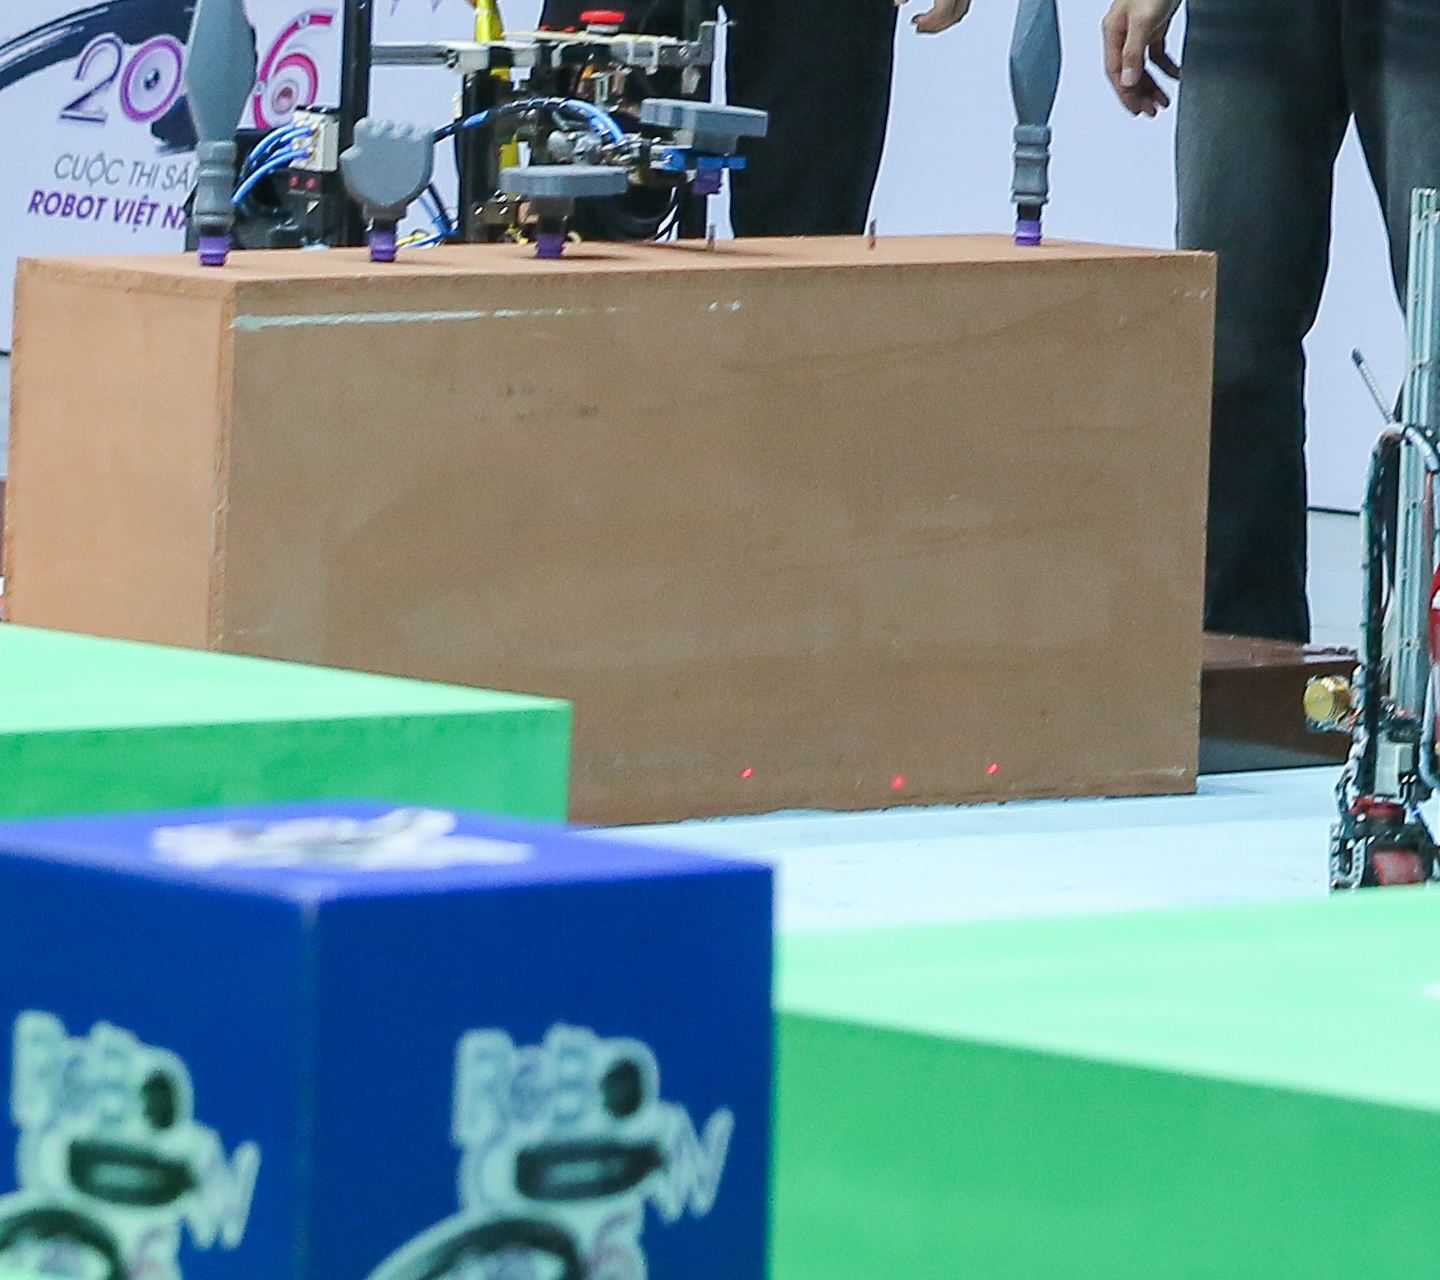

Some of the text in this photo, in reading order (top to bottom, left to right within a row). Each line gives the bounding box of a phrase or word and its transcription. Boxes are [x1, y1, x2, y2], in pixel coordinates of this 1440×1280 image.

[53, 151, 196, 192] CUỘC THI SÁ
[28, 189, 107, 221] ROBOT
[111, 197, 160, 234] VIỆT
